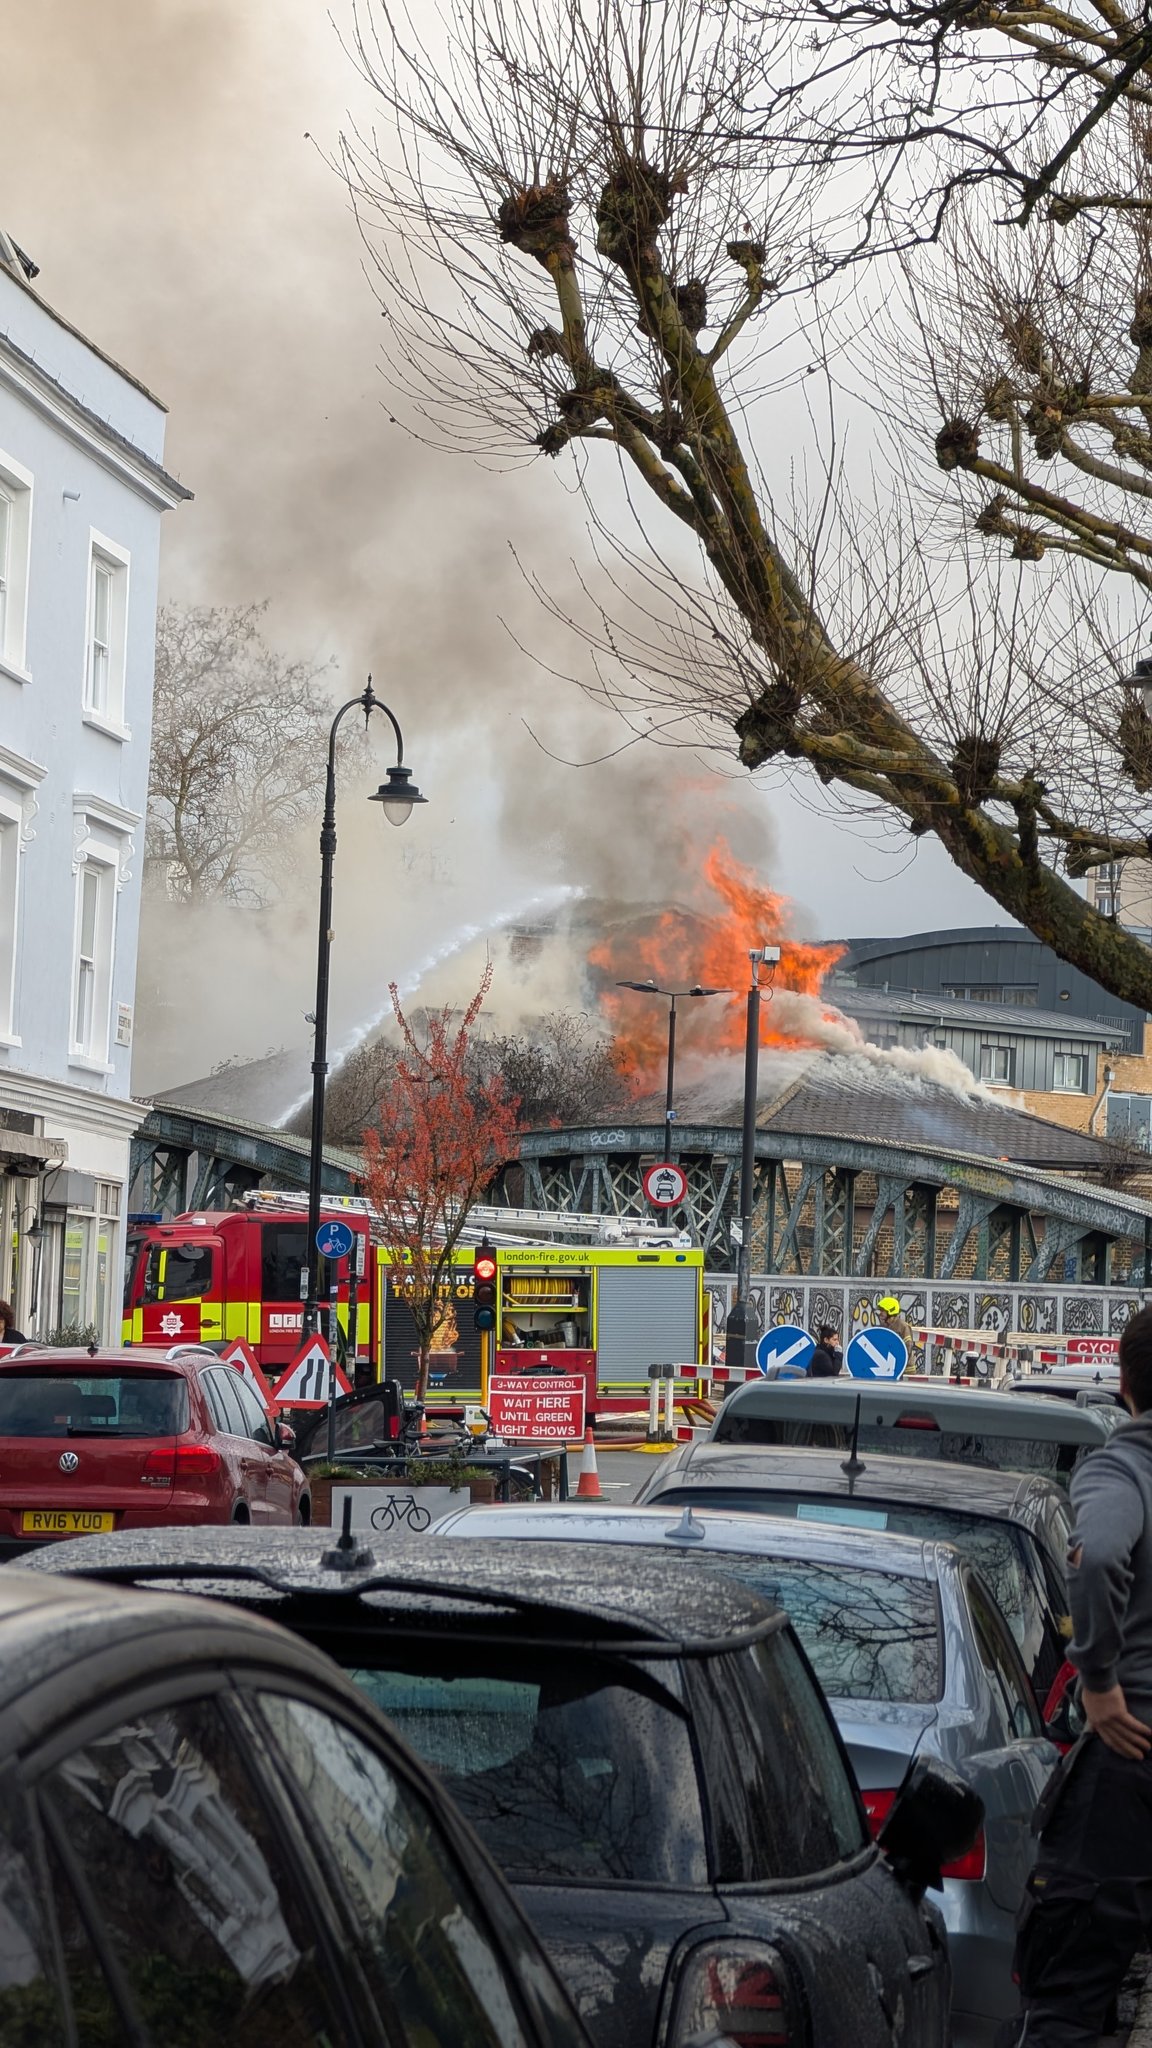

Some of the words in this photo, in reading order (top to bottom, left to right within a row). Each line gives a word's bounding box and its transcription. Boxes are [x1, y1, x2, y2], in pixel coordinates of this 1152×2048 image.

[330, 1225, 339, 1235] P
[503, 1252, 589, 1263] london-fire.gov.uk
[456, 1285, 475, 1298] OF
[271, 1315, 304, 1327] LF
[497, 1380, 529, 1389] 3-WAY
[532, 1380, 576, 1389] CONTROL
[503, 1398, 532, 1408] WAIT
[536, 1397, 570, 1408] HERE
[500, 1411, 531, 1421] UNTIL
[535, 1412, 572, 1422] GREEN
[495, 1424, 527, 1434] LIGHT
[531, 1425, 576, 1435] SHOWS
[33, 1514, 67, 1528] RV16
[71, 1514, 102, 1529] YUO
